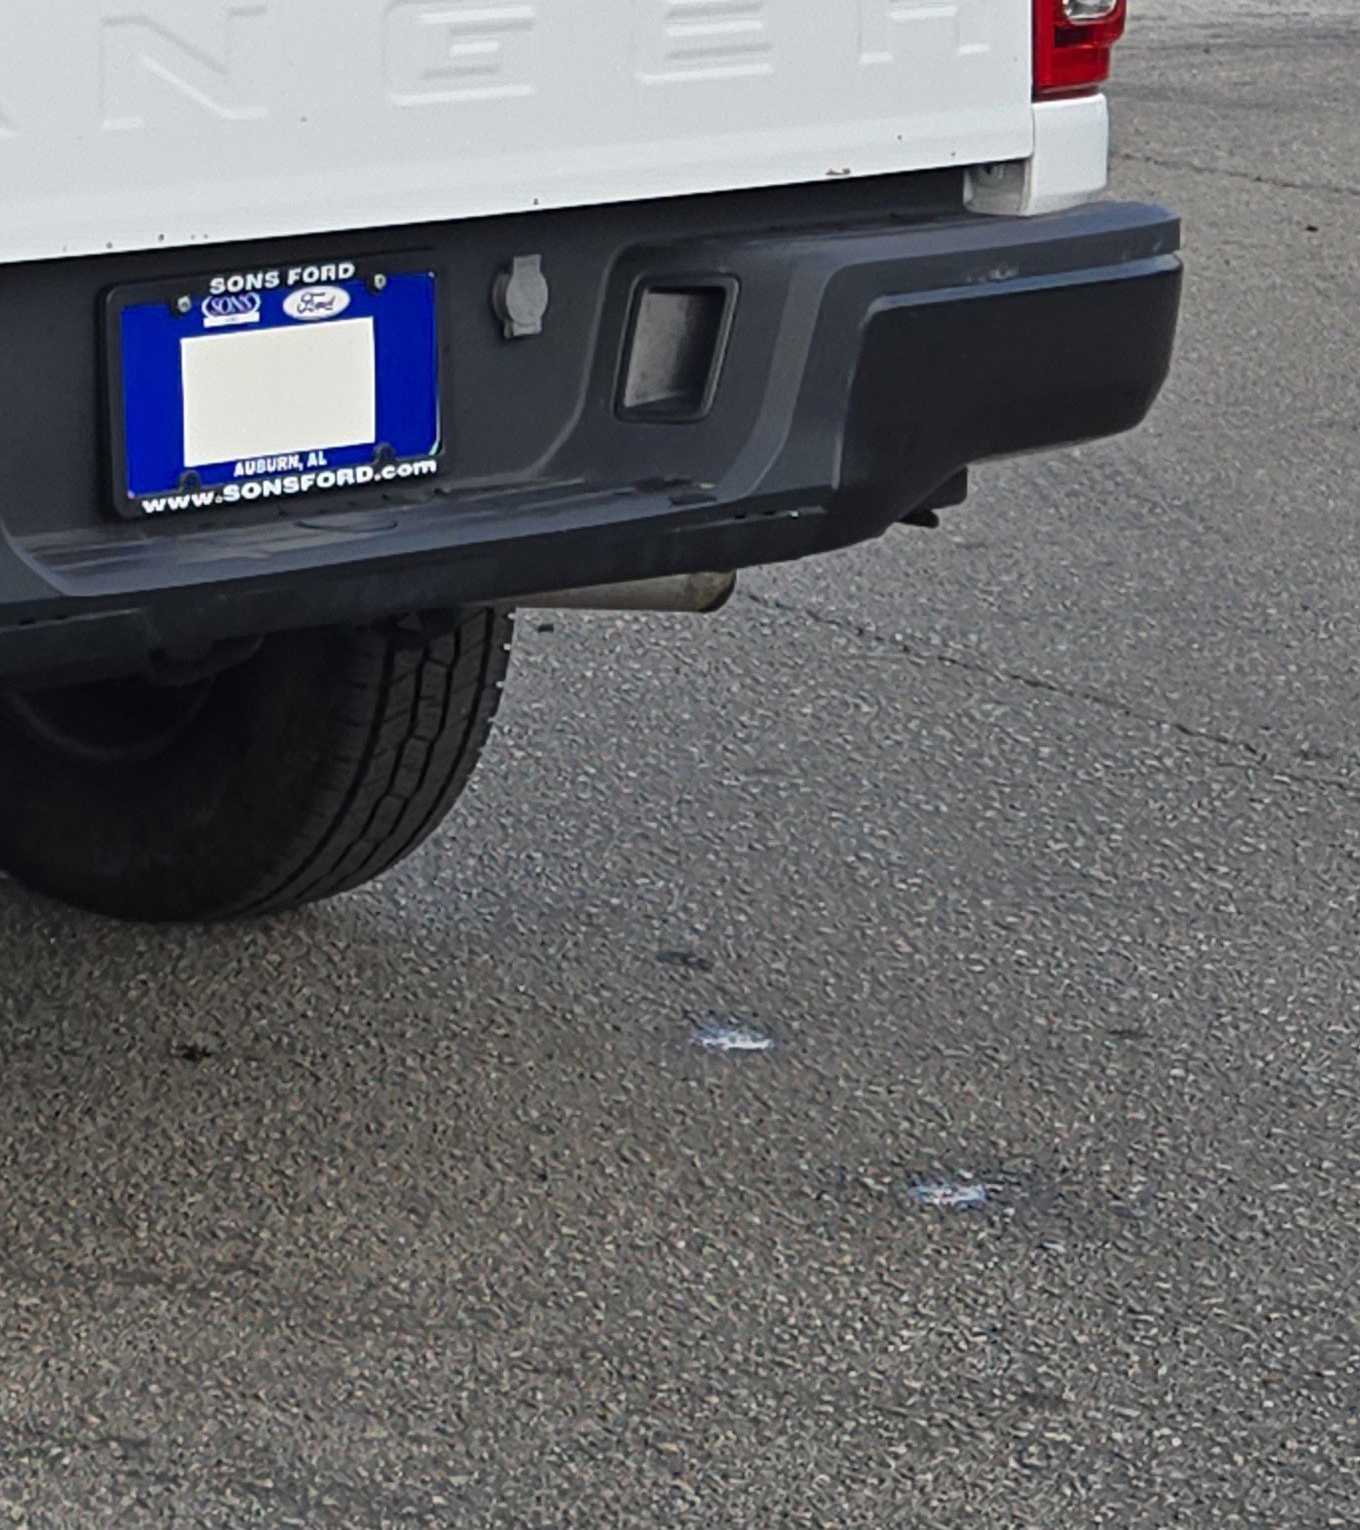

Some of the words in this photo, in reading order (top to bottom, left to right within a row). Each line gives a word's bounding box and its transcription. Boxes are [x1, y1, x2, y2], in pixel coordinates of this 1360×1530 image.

[209, 271, 280, 295] SONS
[287, 262, 356, 286] FORD
[296, 291, 336, 314] Ford
[233, 454, 304, 478] AUBURN,
[307, 450, 328, 468] AL
[141, 459, 438, 514] www.SONSFORD.com
